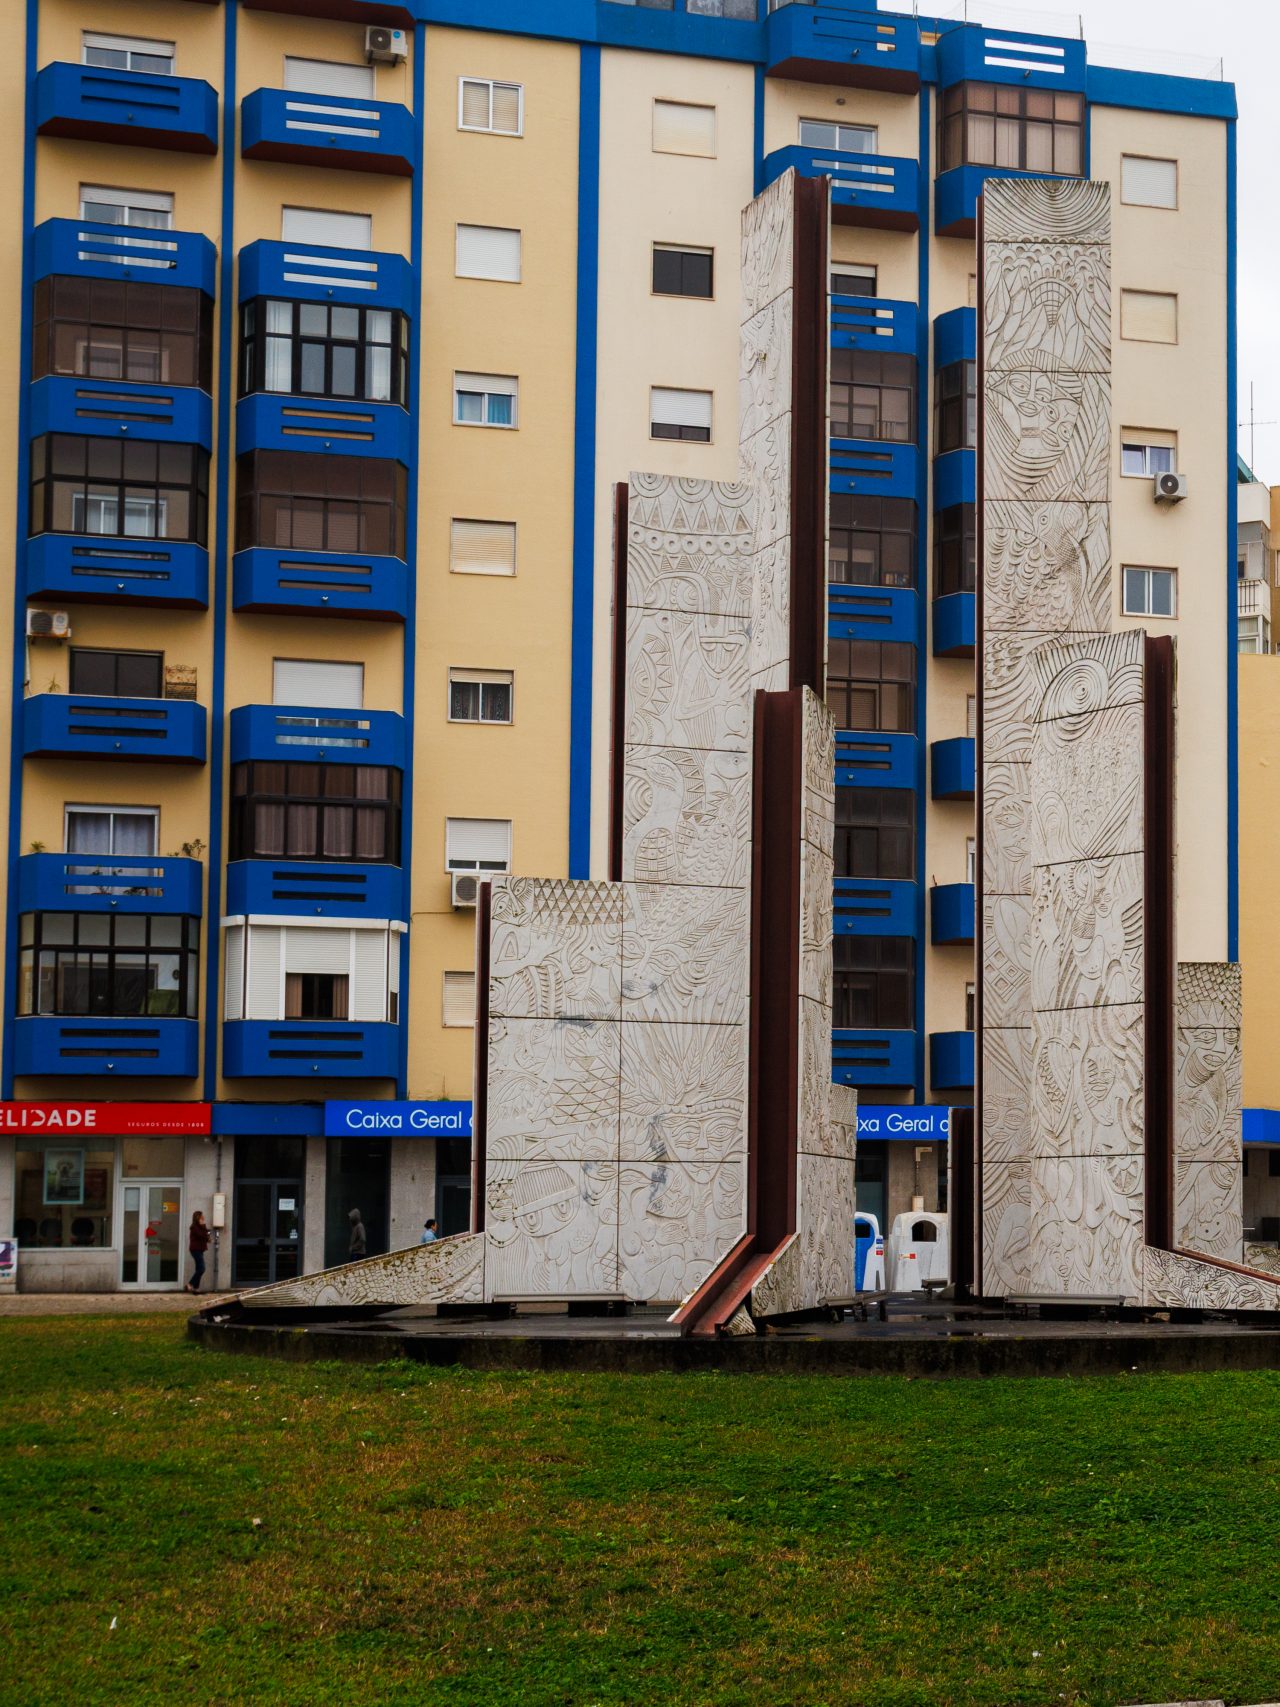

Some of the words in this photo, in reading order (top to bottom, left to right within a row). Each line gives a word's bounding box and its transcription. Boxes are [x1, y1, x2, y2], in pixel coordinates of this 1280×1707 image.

[0, 1109, 97, 1127] LIDADE
[346, 1108, 403, 1129] Caixa
[409, 1108, 462, 1129] Geral
[856, 1115, 880, 1132] ixa
[886, 1113, 934, 1132] Geral
